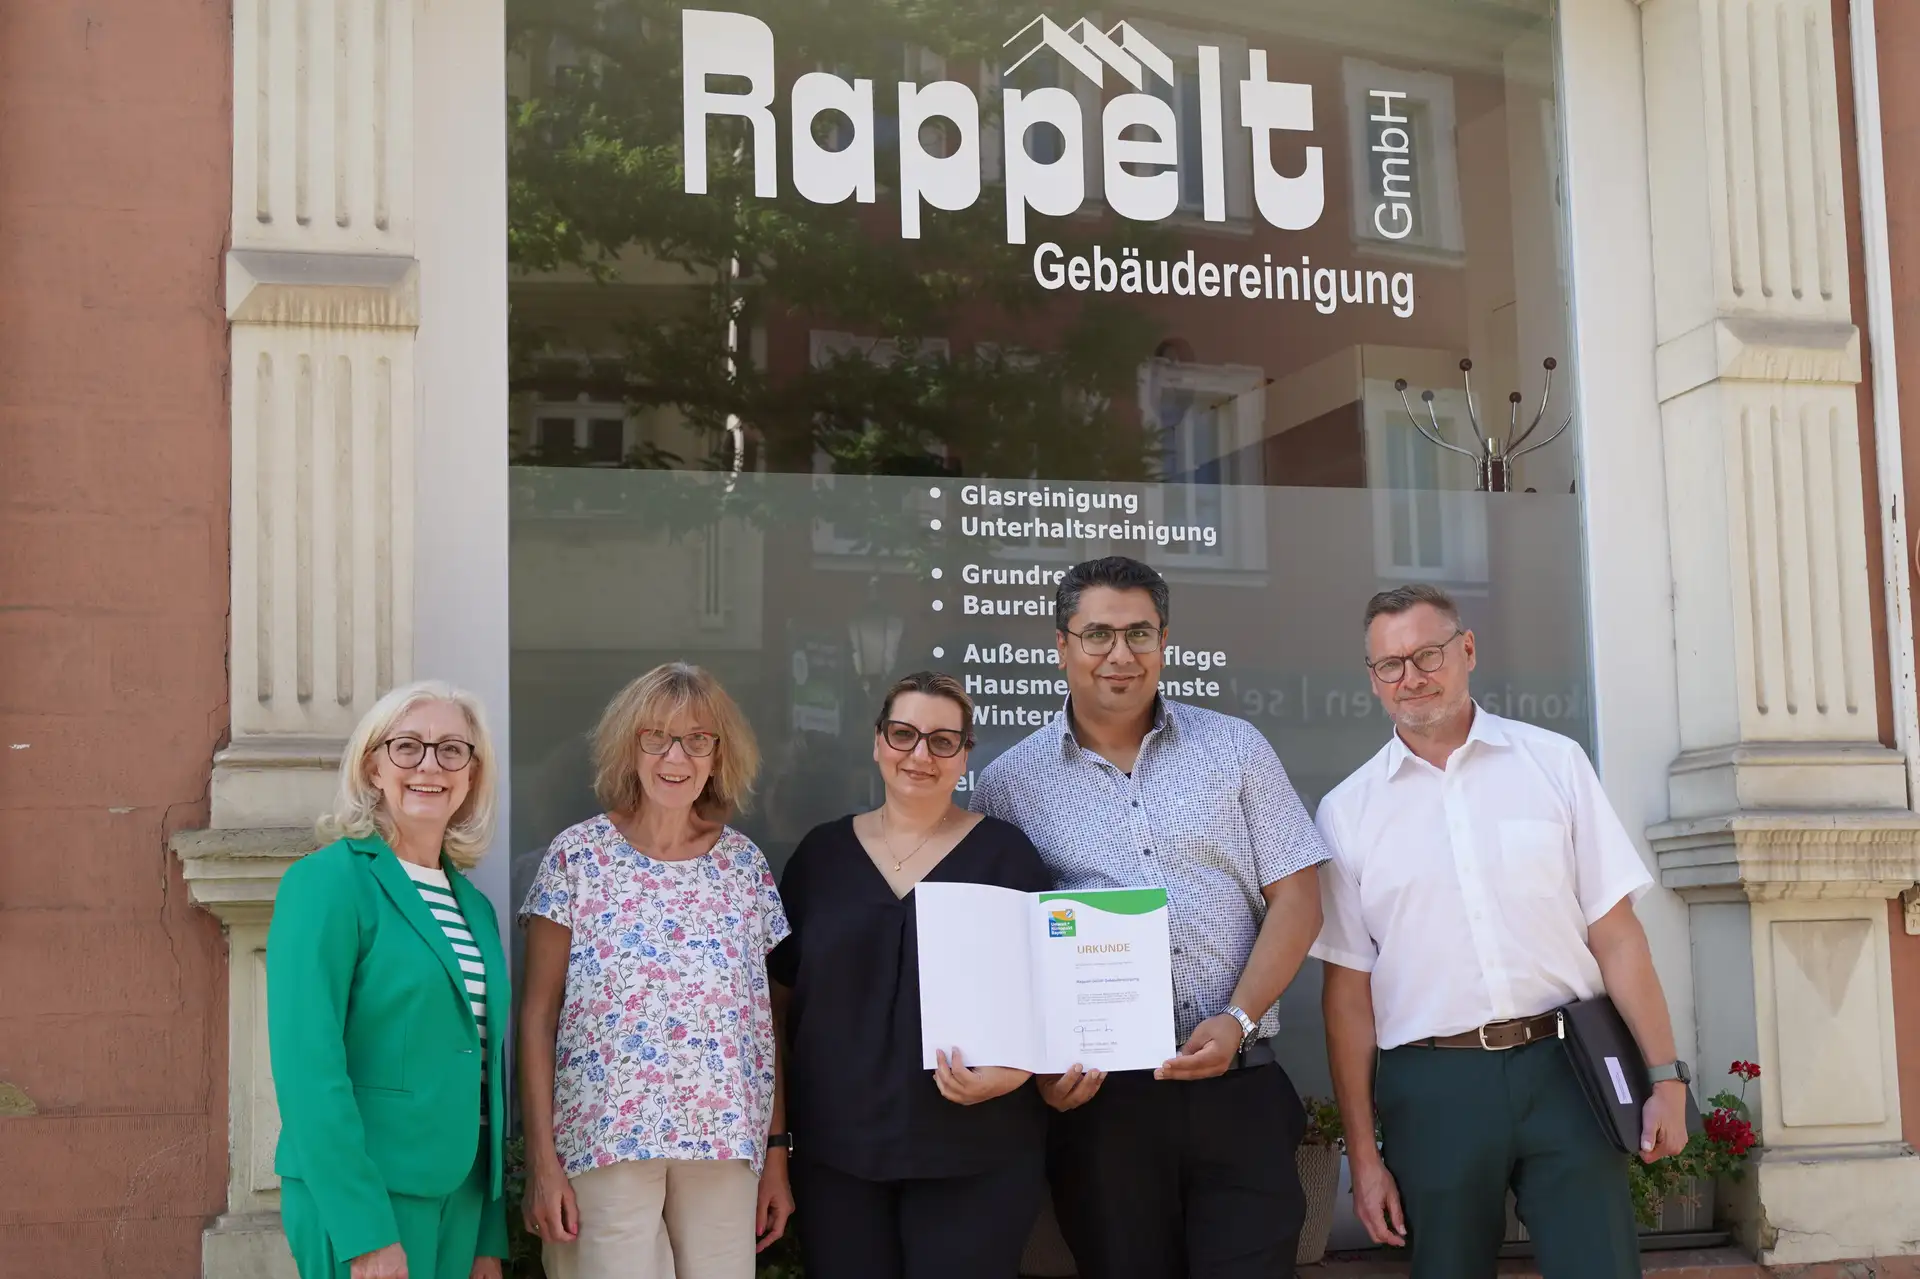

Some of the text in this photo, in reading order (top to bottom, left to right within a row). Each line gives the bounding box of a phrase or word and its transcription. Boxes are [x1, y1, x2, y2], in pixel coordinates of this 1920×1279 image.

[682, 9, 1324, 245] Rappelt
[1369, 90, 1413, 240] GmbH
[1033, 242, 1416, 318] Gebäudereinigung
[961, 485, 1139, 514] Glasreinigung
[961, 517, 1218, 546] Unterhaltsreinigung
[962, 564, 1069, 586] Grundre
[963, 643, 1227, 671] Außena flege
[965, 674, 1220, 697] Hausme enste
[972, 705, 1061, 726] Winter
[956, 771, 975, 791] el
[1077, 943, 1131, 954] URKUNDE
